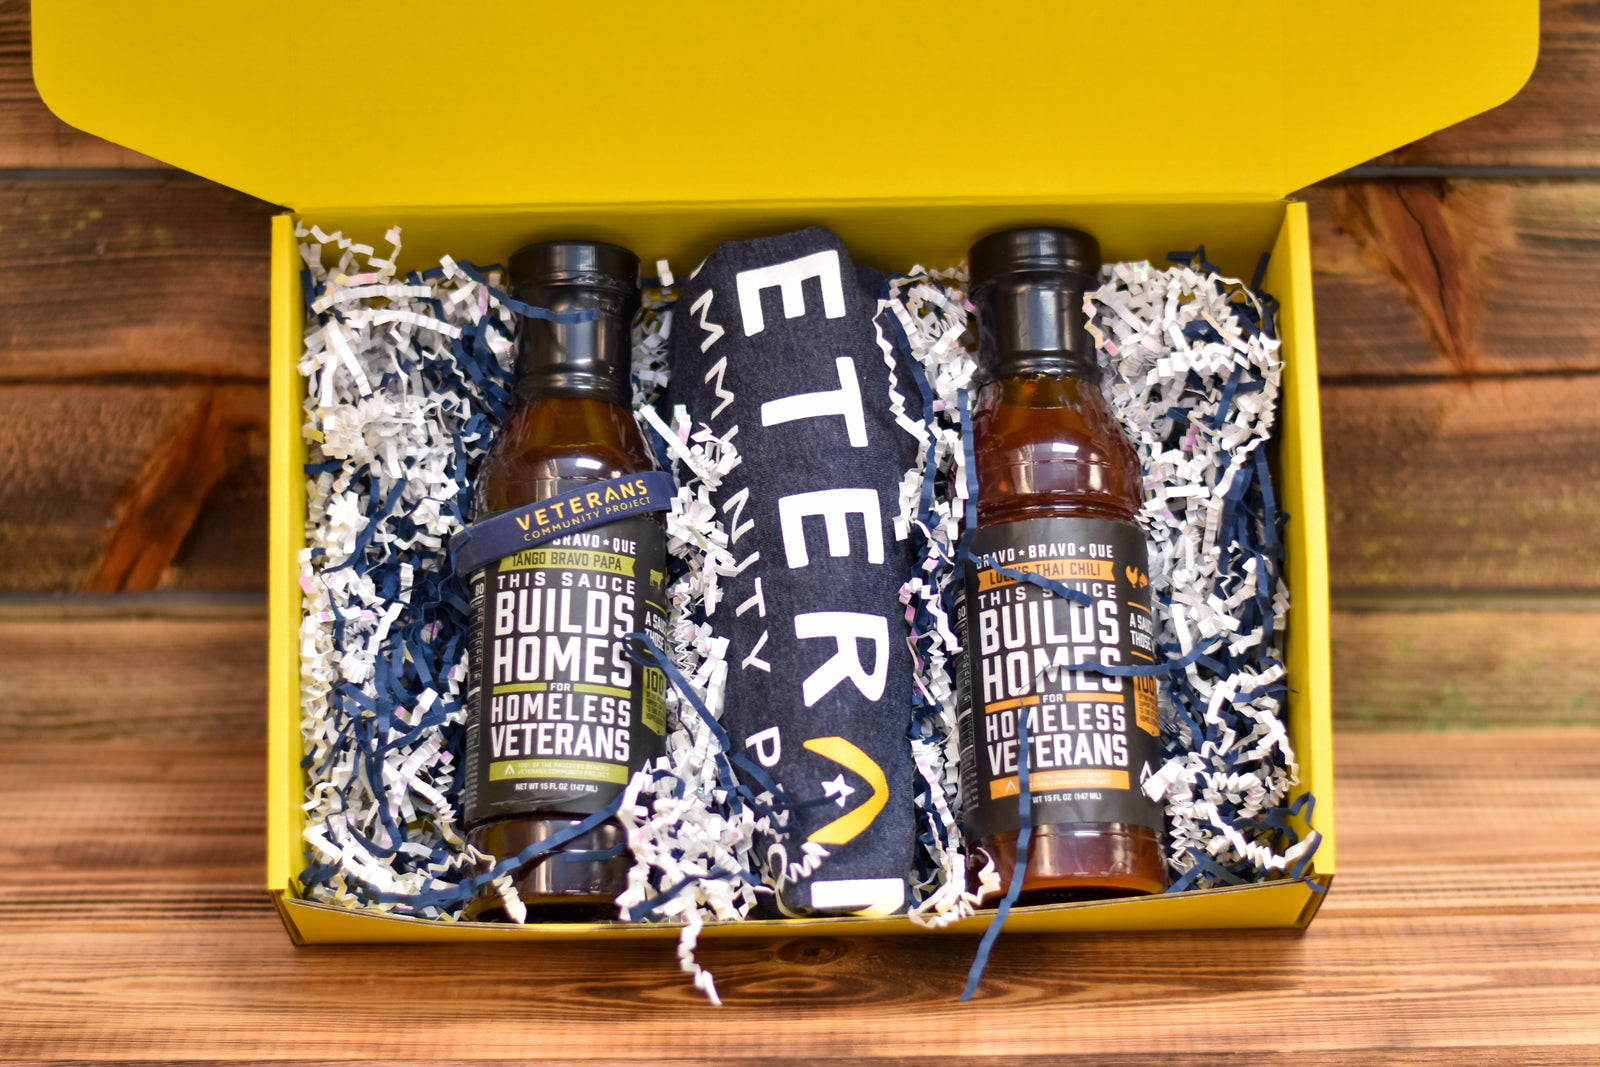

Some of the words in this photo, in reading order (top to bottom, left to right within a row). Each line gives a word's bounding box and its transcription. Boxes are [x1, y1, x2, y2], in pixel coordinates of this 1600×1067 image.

[516, 480, 648, 531] VETERANS
[523, 510, 600, 541] COMMUNITY
[605, 496, 651, 515] PROJECT
[612, 537, 636, 555] QUE
[1028, 543, 1075, 559] BRAVO
[1088, 543, 1114, 559] QUE
[511, 551, 546, 567] TANGO
[550, 551, 589, 566] BRAVO
[593, 553, 622, 571] PAPA
[1035, 562, 1065, 577] THAI
[1070, 562, 1101, 576] CHILI
[497, 571, 546, 590] THIS
[561, 572, 636, 595] SAUCE
[978, 586, 1027, 609] THIS
[1043, 582, 1117, 598] SUCE
[495, 588, 635, 639] BUILDS
[645, 610, 652, 627] A
[1129, 612, 1137, 628] A
[979, 599, 1120, 656] BUILDS
[1130, 629, 1152, 652] THOSE
[493, 636, 633, 688] HOMES
[982, 646, 1124, 703] HOMES
[550, 682, 571, 692] FOR
[1042, 693, 1064, 704] FOR
[490, 692, 631, 728] HOMELESS
[985, 703, 1127, 743] HOMELESS
[490, 722, 630, 762] VETERANS
[515, 782, 527, 791] NET
[528, 782, 539, 790] WT
[540, 782, 548, 790] 15
[549, 782, 558, 790] FL
[558, 782, 568, 790] OZ
[570, 782, 584, 792] (147
[1032, 795, 1042, 804] WT
[1044, 794, 1052, 802] 15
[1053, 793, 1061, 801] FL
[1062, 793, 1072, 801] OZ
[1074, 792, 1088, 801] (147
